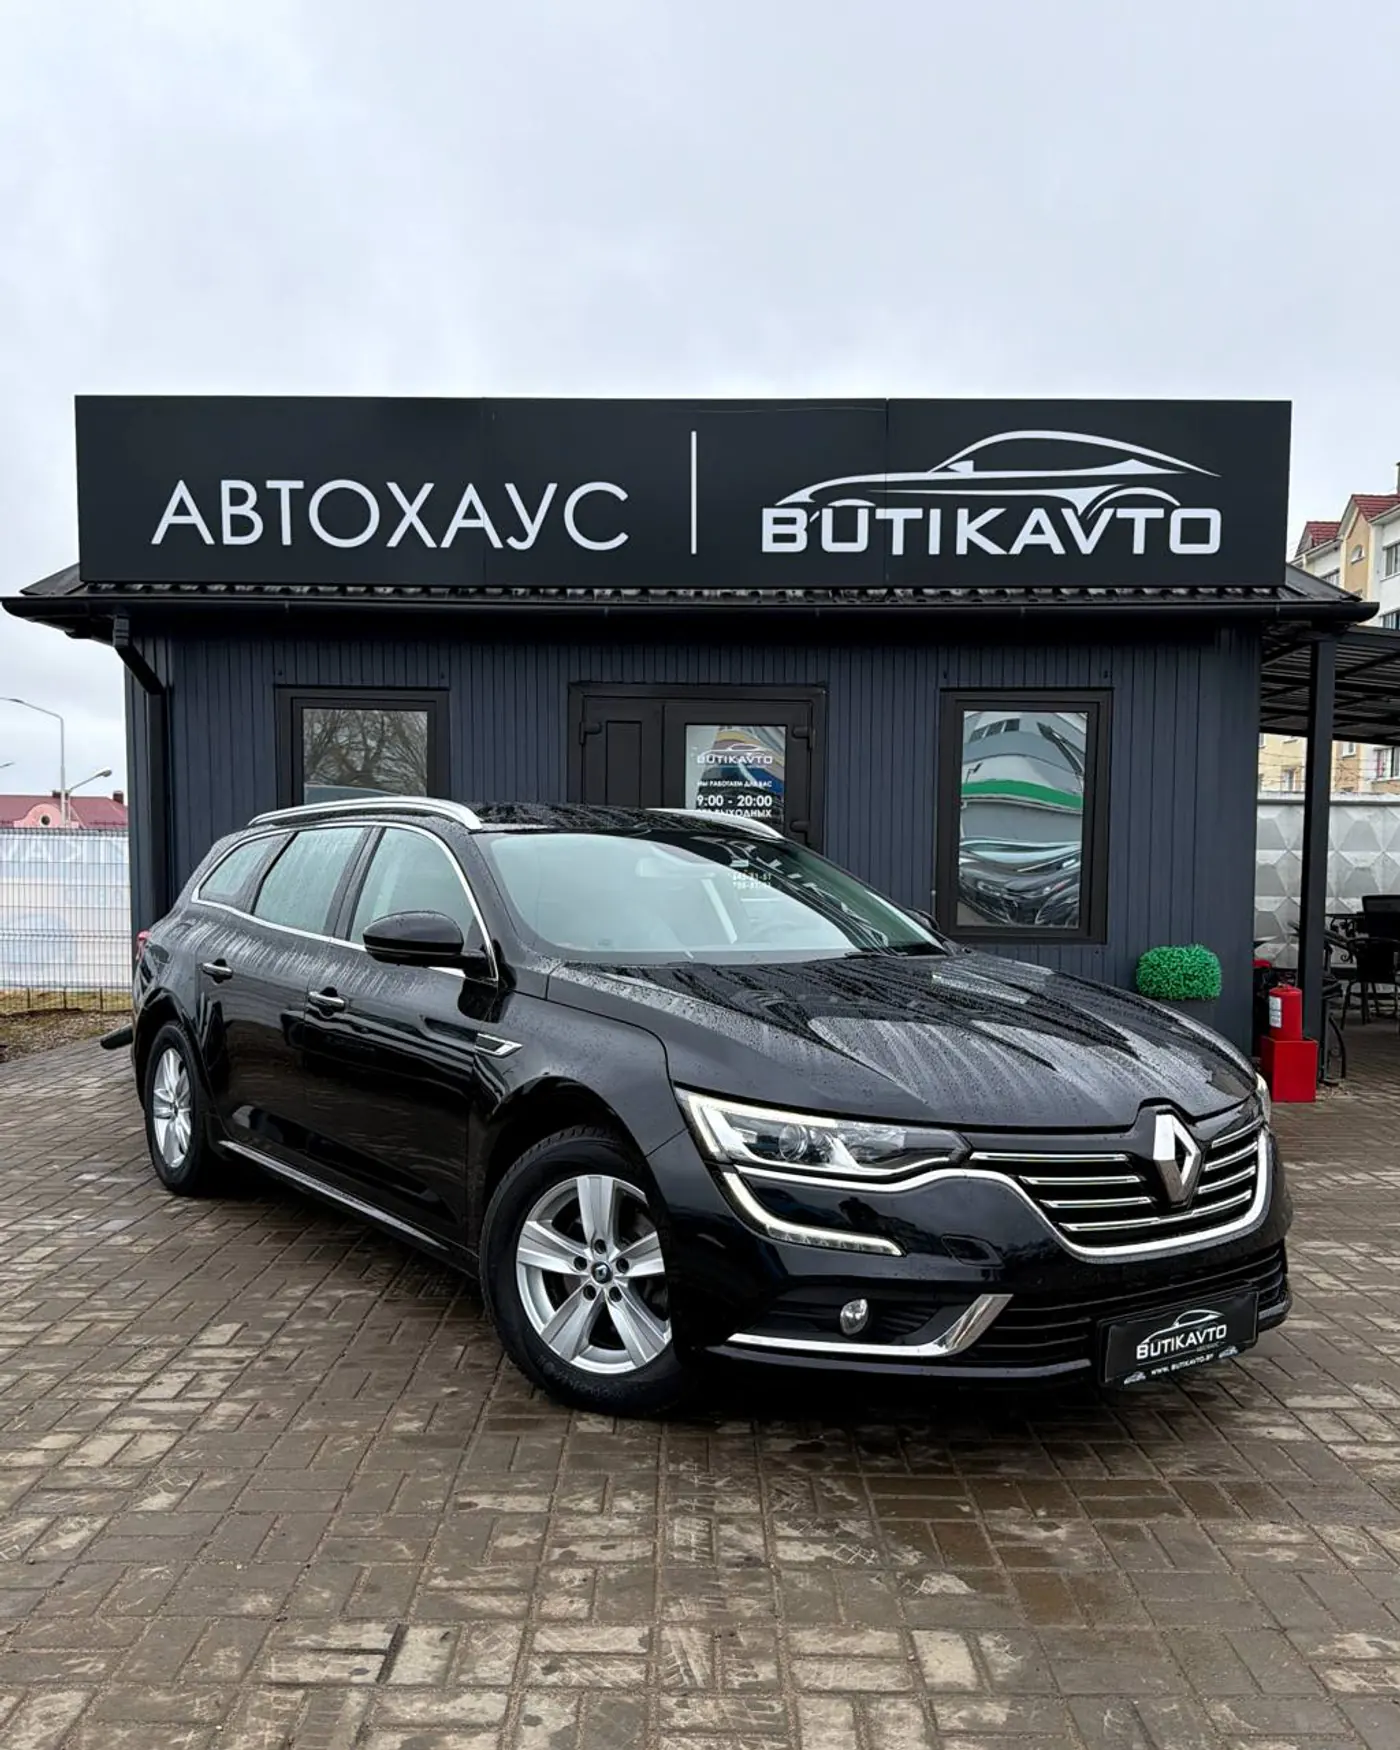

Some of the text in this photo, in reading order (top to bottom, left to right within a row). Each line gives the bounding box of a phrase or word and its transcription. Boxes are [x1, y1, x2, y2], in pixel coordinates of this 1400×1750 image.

[151, 479, 629, 551] АВТОХАУС
[761, 507, 1222, 555] BUTIKAVTO
[697, 795, 724, 807] 9:00
[736, 795, 773, 807] 20:00
[1136, 1324, 1227, 1360] BUTIKAVTO
